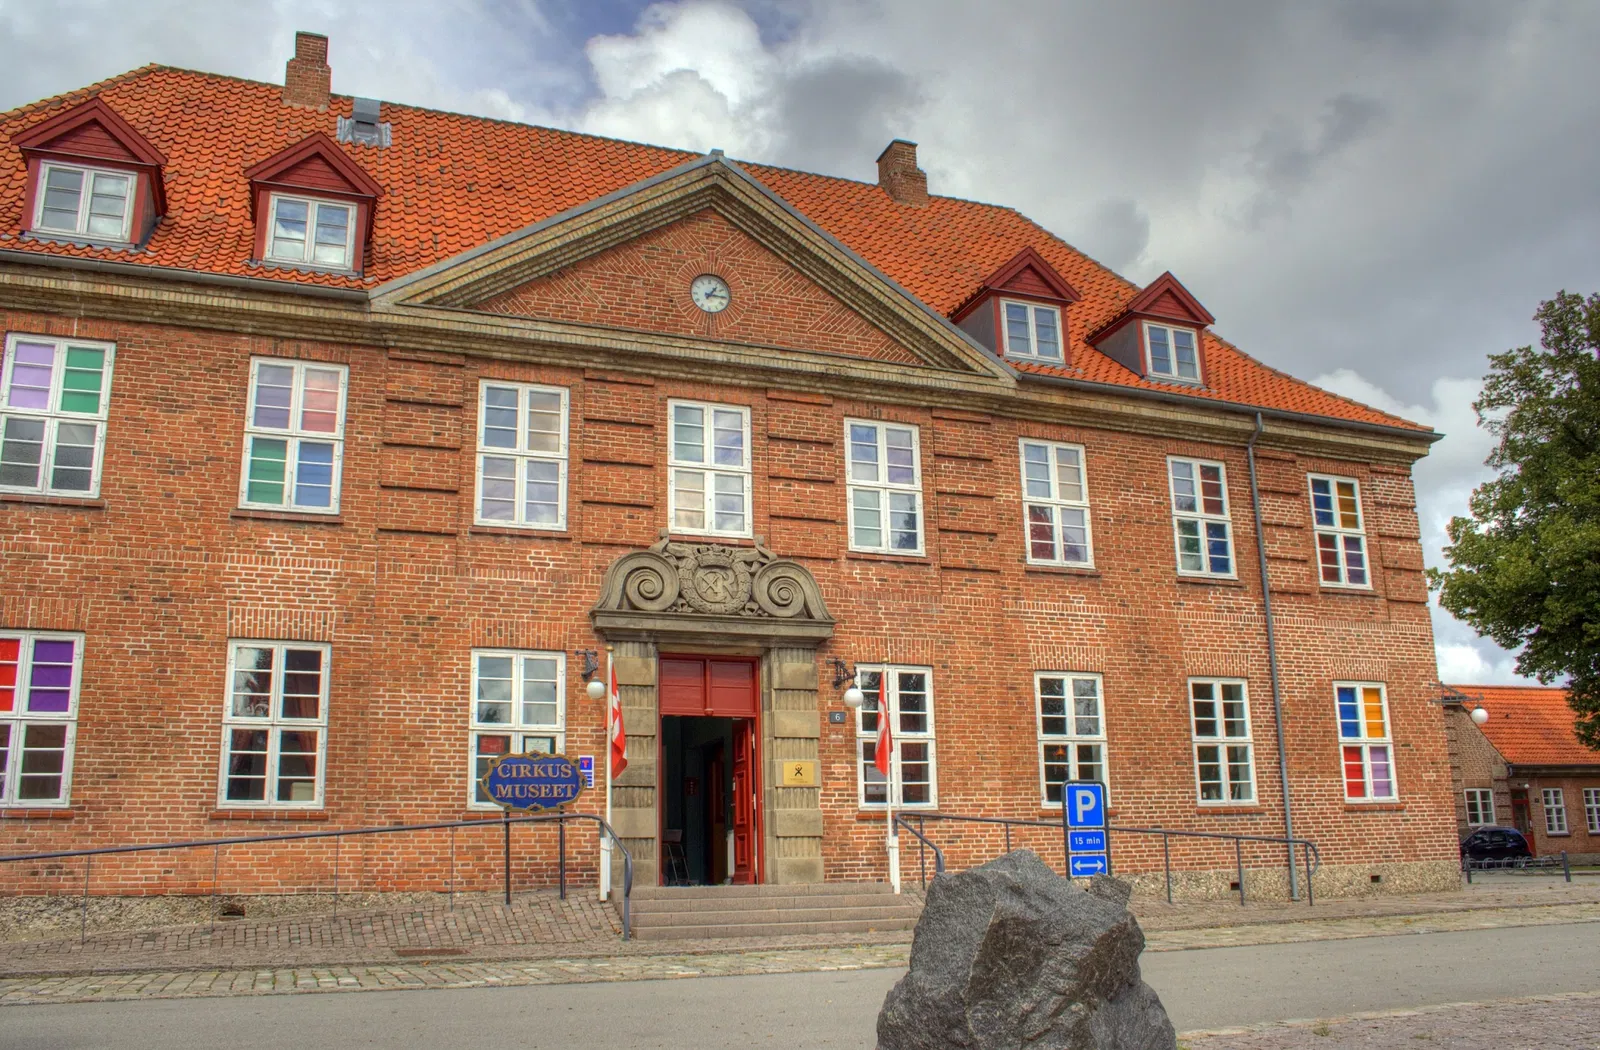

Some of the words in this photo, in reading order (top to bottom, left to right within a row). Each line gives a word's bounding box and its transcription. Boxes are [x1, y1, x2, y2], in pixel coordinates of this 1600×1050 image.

[835, 713, 841, 721] 6
[497, 764, 572, 778] CIRKUS
[496, 784, 576, 798] MUSEET
[1076, 790, 1096, 822] P
[1086, 836, 1100, 844] min
